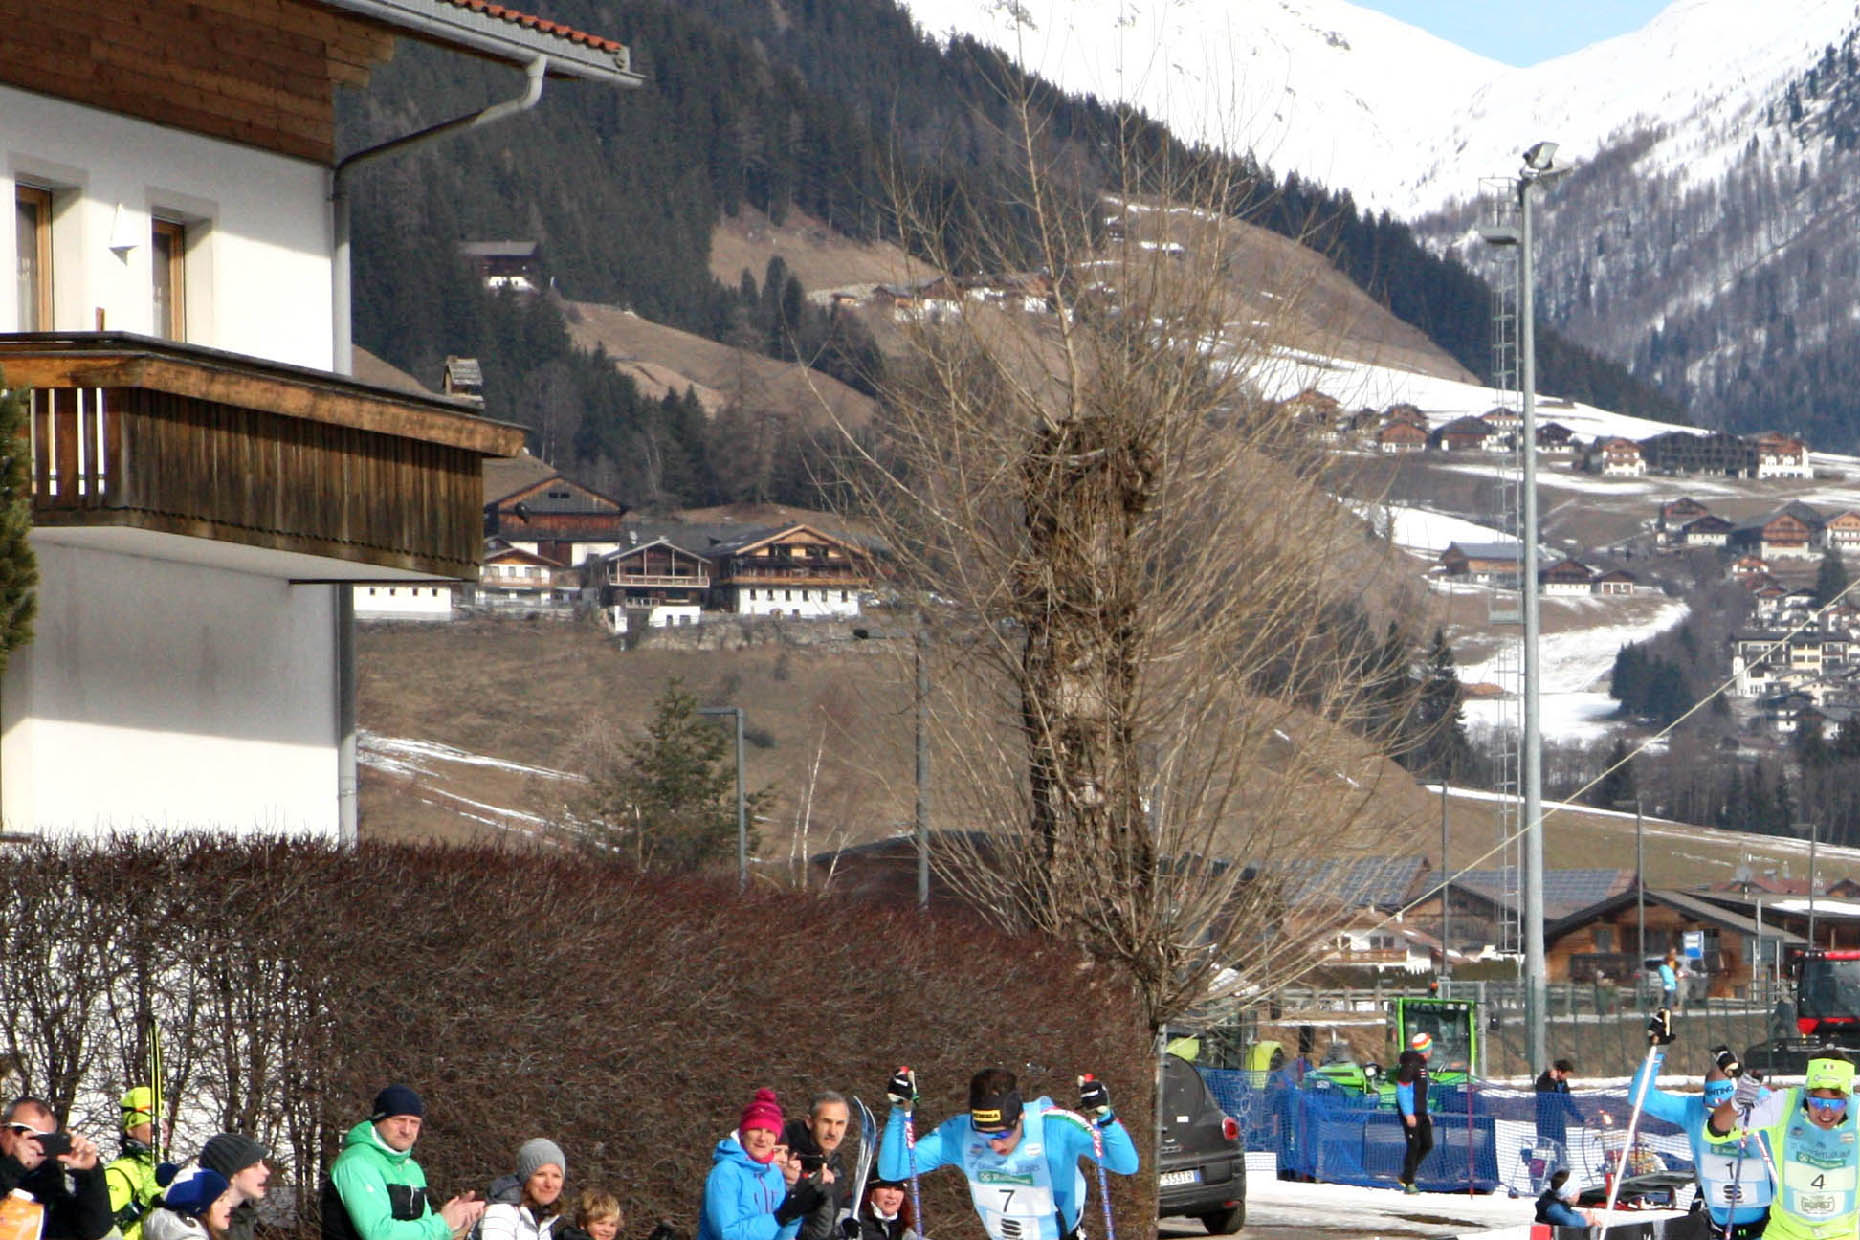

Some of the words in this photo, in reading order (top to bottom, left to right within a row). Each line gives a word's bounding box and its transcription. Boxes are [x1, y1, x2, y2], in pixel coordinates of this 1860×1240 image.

[1725, 1161, 1735, 1180] 1
[1810, 1173, 1825, 1190] 4
[998, 1188, 1015, 1213] 7
